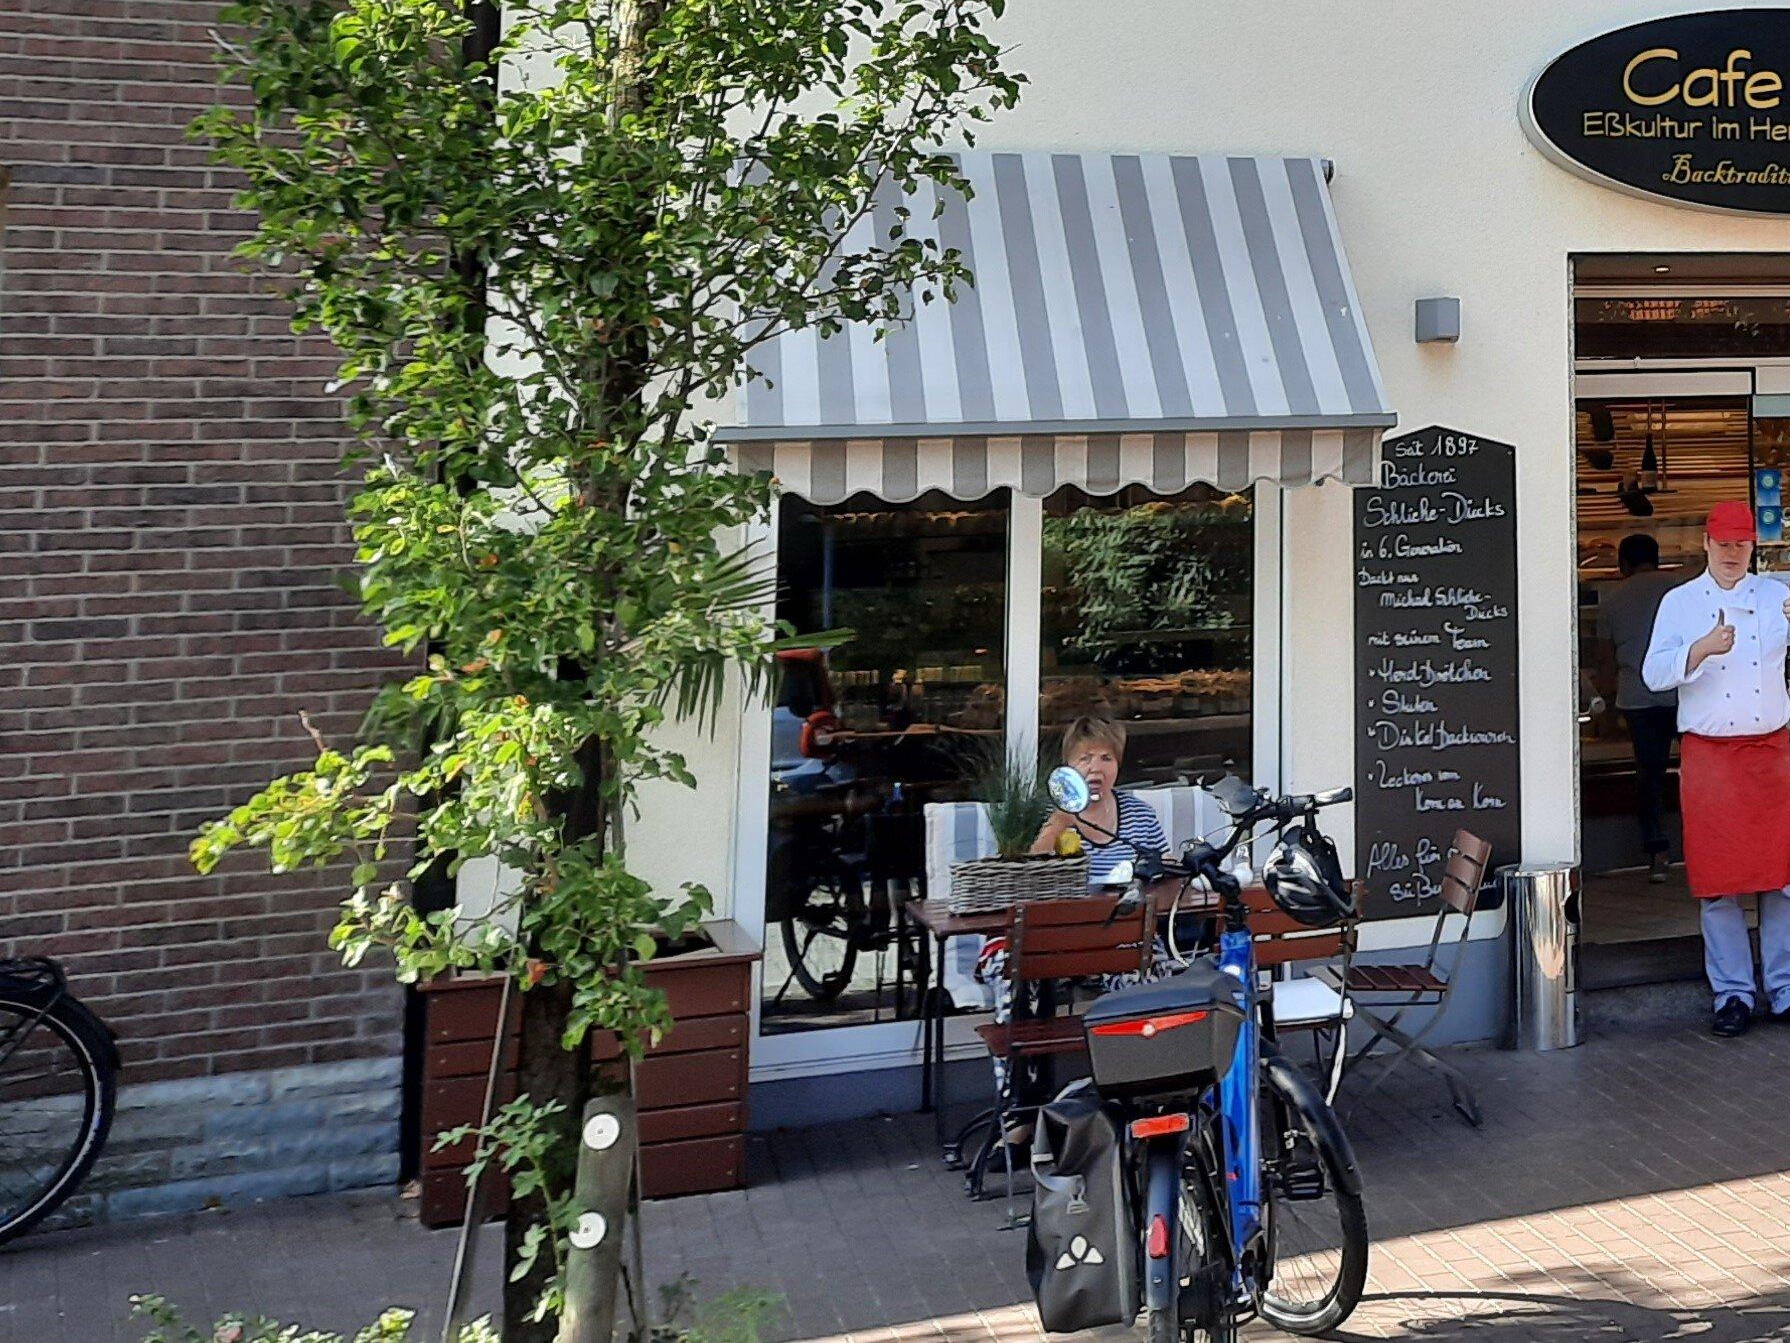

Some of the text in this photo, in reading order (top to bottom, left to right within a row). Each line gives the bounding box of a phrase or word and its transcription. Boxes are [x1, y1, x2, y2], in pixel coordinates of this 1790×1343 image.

[1623, 49, 1782, 109] Cafe
[1583, 111, 1703, 139] Eßkultur
[1712, 115, 1741, 140] im
[1430, 435, 1479, 456] 1897
[1366, 842, 1409, 879] Alles
